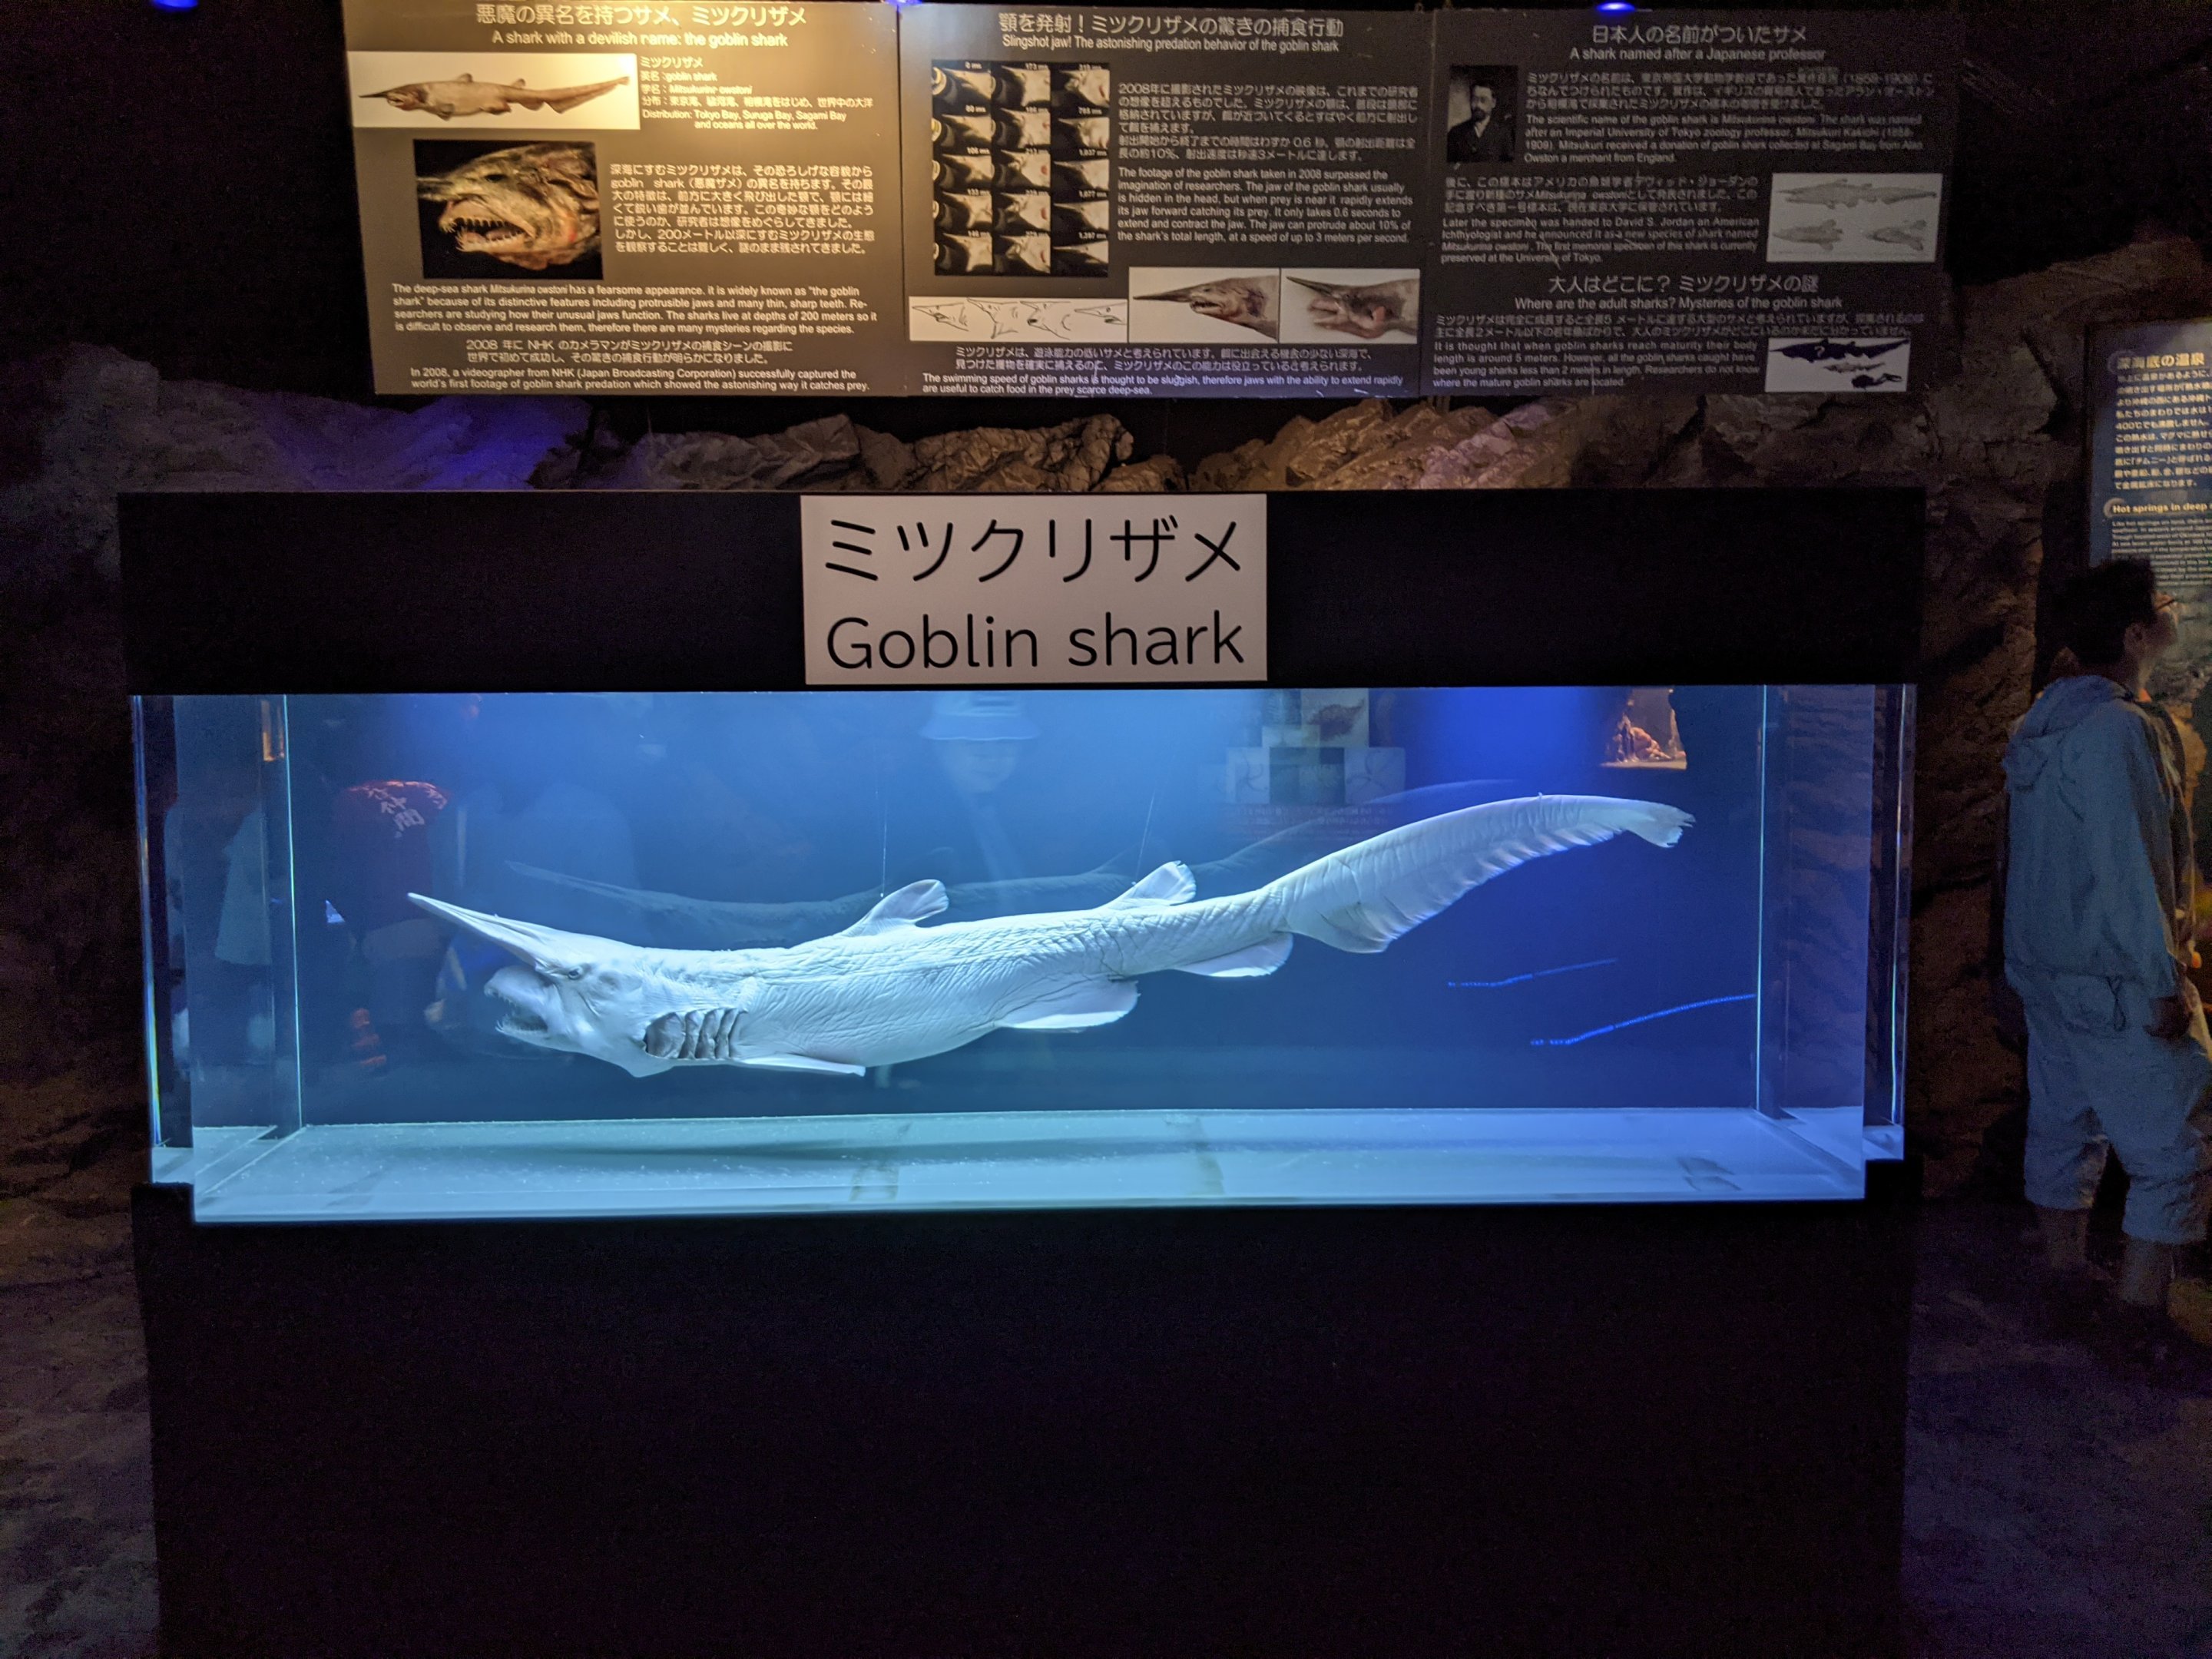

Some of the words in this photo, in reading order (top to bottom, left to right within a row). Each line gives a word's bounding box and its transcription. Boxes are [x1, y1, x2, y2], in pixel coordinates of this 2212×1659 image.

[492, 30, 503, 44] A
[505, 30, 542, 45] shark
[545, 31, 572, 45] with
[575, 34, 584, 45] a
[587, 31, 637, 45] devilish
[684, 32, 705, 46] the
[707, 32, 748, 49] goblin
[750, 33, 788, 47] shark
[1592, 25, 1806, 45] 日本人の名前がついたサメ
[1002, 35, 1049, 50] Slingshot
[1050, 36, 1071, 51] jaw!
[1073, 37, 1094, 48] The
[1095, 37, 1153, 51] astonishing
[1154, 38, 1201, 52] predation
[1203, 38, 1247, 51] behavior
[1248, 39, 1259, 51] of
[1260, 39, 1277, 51] the
[1278, 40, 1310, 54] goblin
[1310, 40, 1339, 52] shark
[1570, 48, 1580, 60] A
[1582, 48, 1617, 60] shark
[1619, 48, 1661, 60] named
[1664, 48, 1693, 60] after
[1694, 51, 1704, 60] a
[1706, 48, 1766, 62] Japanese
[1768, 48, 1825, 62] professor
[640, 57, 704, 68] ミツクリザメ
[1118, 167, 1137, 178] The
[1138, 168, 1173, 180] footage
[1174, 168, 1184, 178] of
[1186, 168, 1201, 179] the
[1203, 168, 1231, 181] goblin
[1232, 168, 1258, 179] shark
[1260, 169, 1286, 179] taken
[1287, 169, 1296, 179] in
[1298, 169, 1322, 180] 2008
[1323, 169, 1371, 182] surpassed
[1373, 169, 1387, 180] the
[392, 283, 412, 293] The
[413, 283, 459, 296] deep-sea
[461, 284, 488, 294] shark
[568, 284, 587, 294] has
[588, 286, 594, 295] a
[596, 285, 642, 295] fearsome
[716, 285, 726, 296] is
[727, 286, 758, 297] widely
[760, 286, 792, 296] known
[830, 286, 860, 298] goblin
[426, 296, 469, 306] because
[471, 296, 482, 306] of
[483, 296, 496, 306] its
[498, 296, 548, 306] distinctive
[549, 297, 590, 307] features
[591, 297, 636, 310] including
[637, 297, 690, 310] protrusible
[691, 298, 714, 310] jaws
[716, 298, 735, 308] and
[737, 300, 764, 310] many
[789, 298, 817, 310] sharp
[1515, 297, 1553, 310] Where
[1555, 300, 1575, 310] are
[1577, 297, 1596, 309] the
[1598, 297, 1628, 309] adult
[1629, 297, 1676, 309] sharks?
[1678, 296, 1734, 311] Mysteries
[1736, 296, 1749, 309] of
[1750, 296, 1770, 308] the
[1772, 296, 1808, 311] goblin
[1810, 296, 1842, 308] shark
[393, 309, 443, 319] searchers
[464, 310, 506, 321] studying
[508, 310, 529, 320] how
[531, 310, 554, 320] their
[555, 310, 595, 320] unusual
[596, 310, 620, 322] jaws
[665, 310, 685, 320] The
[687, 310, 720, 320] sharks
[721, 310, 739, 320] live
[740, 311, 751, 320] at
[753, 311, 786, 323] depths
[788, 311, 798, 321] of
[800, 311, 819, 321] 200
[820, 311, 855, 321] meters
[870, 311, 877, 321] it
[395, 322, 404, 332] is
[406, 322, 440, 332] difficult
[442, 322, 452, 332] to
[453, 322, 492, 332] observe
[494, 322, 513, 332] and
[515, 323, 557, 333] research
[588, 323, 631, 333] therefore
[632, 323, 657, 333] there
[677, 325, 704, 335] many
[704, 323, 750, 335] mysteries
[752, 323, 797, 335] regarding
[798, 323, 814, 333] the
[528, 339, 555, 350] NHK
[939, 383, 967, 393] useful
[969, 384, 978, 393] to
[979, 384, 1005, 394] catch
[1005, 384, 1026, 394] food
[1028, 384, 1037, 394] in
[1038, 384, 1053, 394] the
[1055, 386, 1075, 396] prey
[2113, 505, 2131, 513] Hot
[2133, 504, 2168, 513] springs
[2183, 502, 2207, 512] deep
[825, 514, 1240, 582] ミツクリザメ
[826, 613, 1038, 670] Goblin
[1068, 609, 1244, 667] shark
